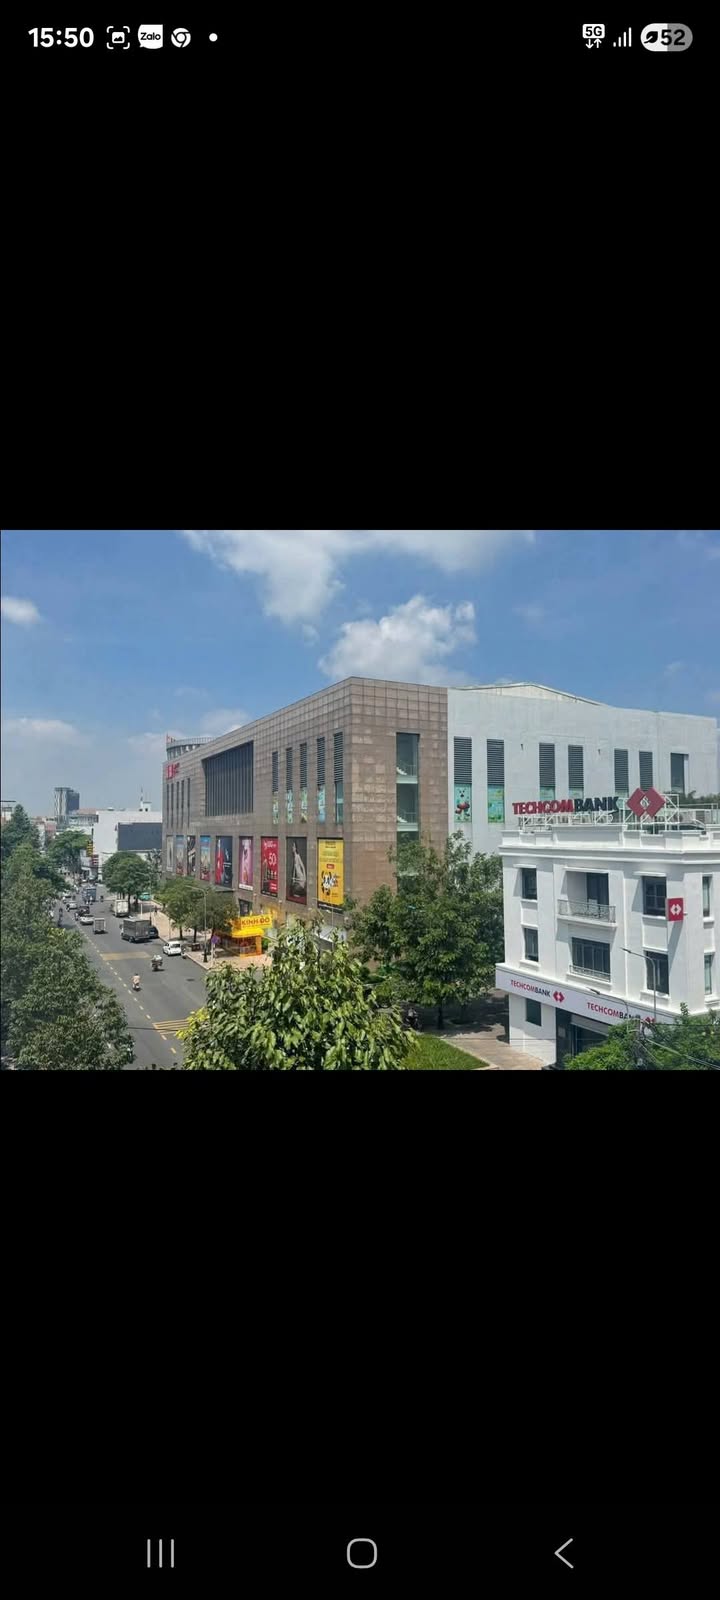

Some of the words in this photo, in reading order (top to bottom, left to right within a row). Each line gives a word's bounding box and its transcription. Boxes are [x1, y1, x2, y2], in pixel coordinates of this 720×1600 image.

[512, 796, 620, 815] TECHCOMBANK
[510, 979, 551, 997] TECHCOMBANK
[587, 1002, 641, 1019] TECHCOMBA
